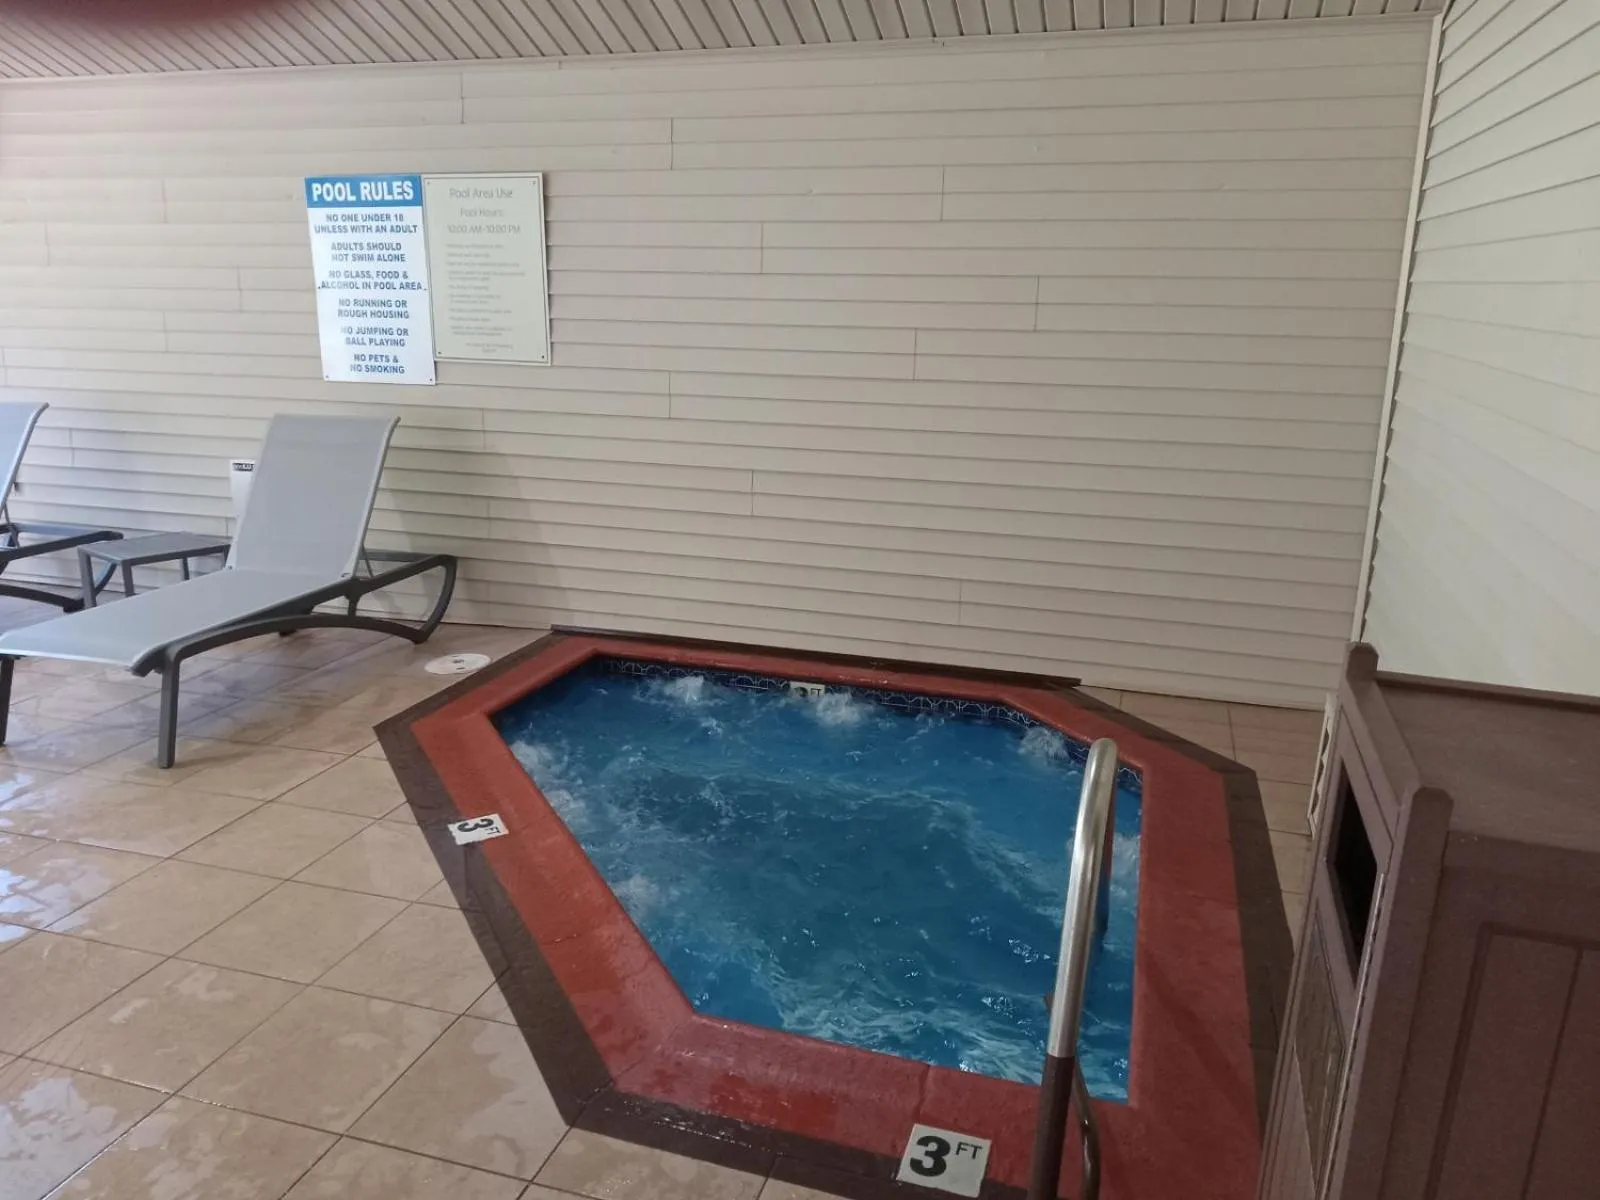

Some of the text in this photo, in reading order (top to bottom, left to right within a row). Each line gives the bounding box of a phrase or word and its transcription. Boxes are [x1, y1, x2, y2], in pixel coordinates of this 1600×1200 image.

[311, 180, 414, 202] POOL RULES
[449, 187, 513, 199] Pool Area Use
[326, 213, 338, 222] NO
[341, 213, 359, 222] ONE
[361, 213, 391, 222] UNDER
[314, 224, 418, 234] UNLESS WITH AN ADULT
[331, 242, 402, 251] ADULTS SHOULD
[332, 253, 406, 262] NOT SWIM ALONE
[328, 270, 408, 280] NO GLASS, FOOD &
[321, 281, 422, 290] ALCOHOL IN POOL AREA
[339, 298, 407, 308] NO RUNNING OR
[337, 309, 410, 319] ROUGH HOUSING
[355, 326, 394, 336] JUMPING
[396, 328, 409, 336] OR
[345, 337, 405, 347] BALL PLAYING
[354, 353, 399, 363] NO PETS &
[350, 364, 405, 374] NO SMOKING
[457, 818, 494, 832] 3
[909, 1135, 983, 1177] 3 FT
